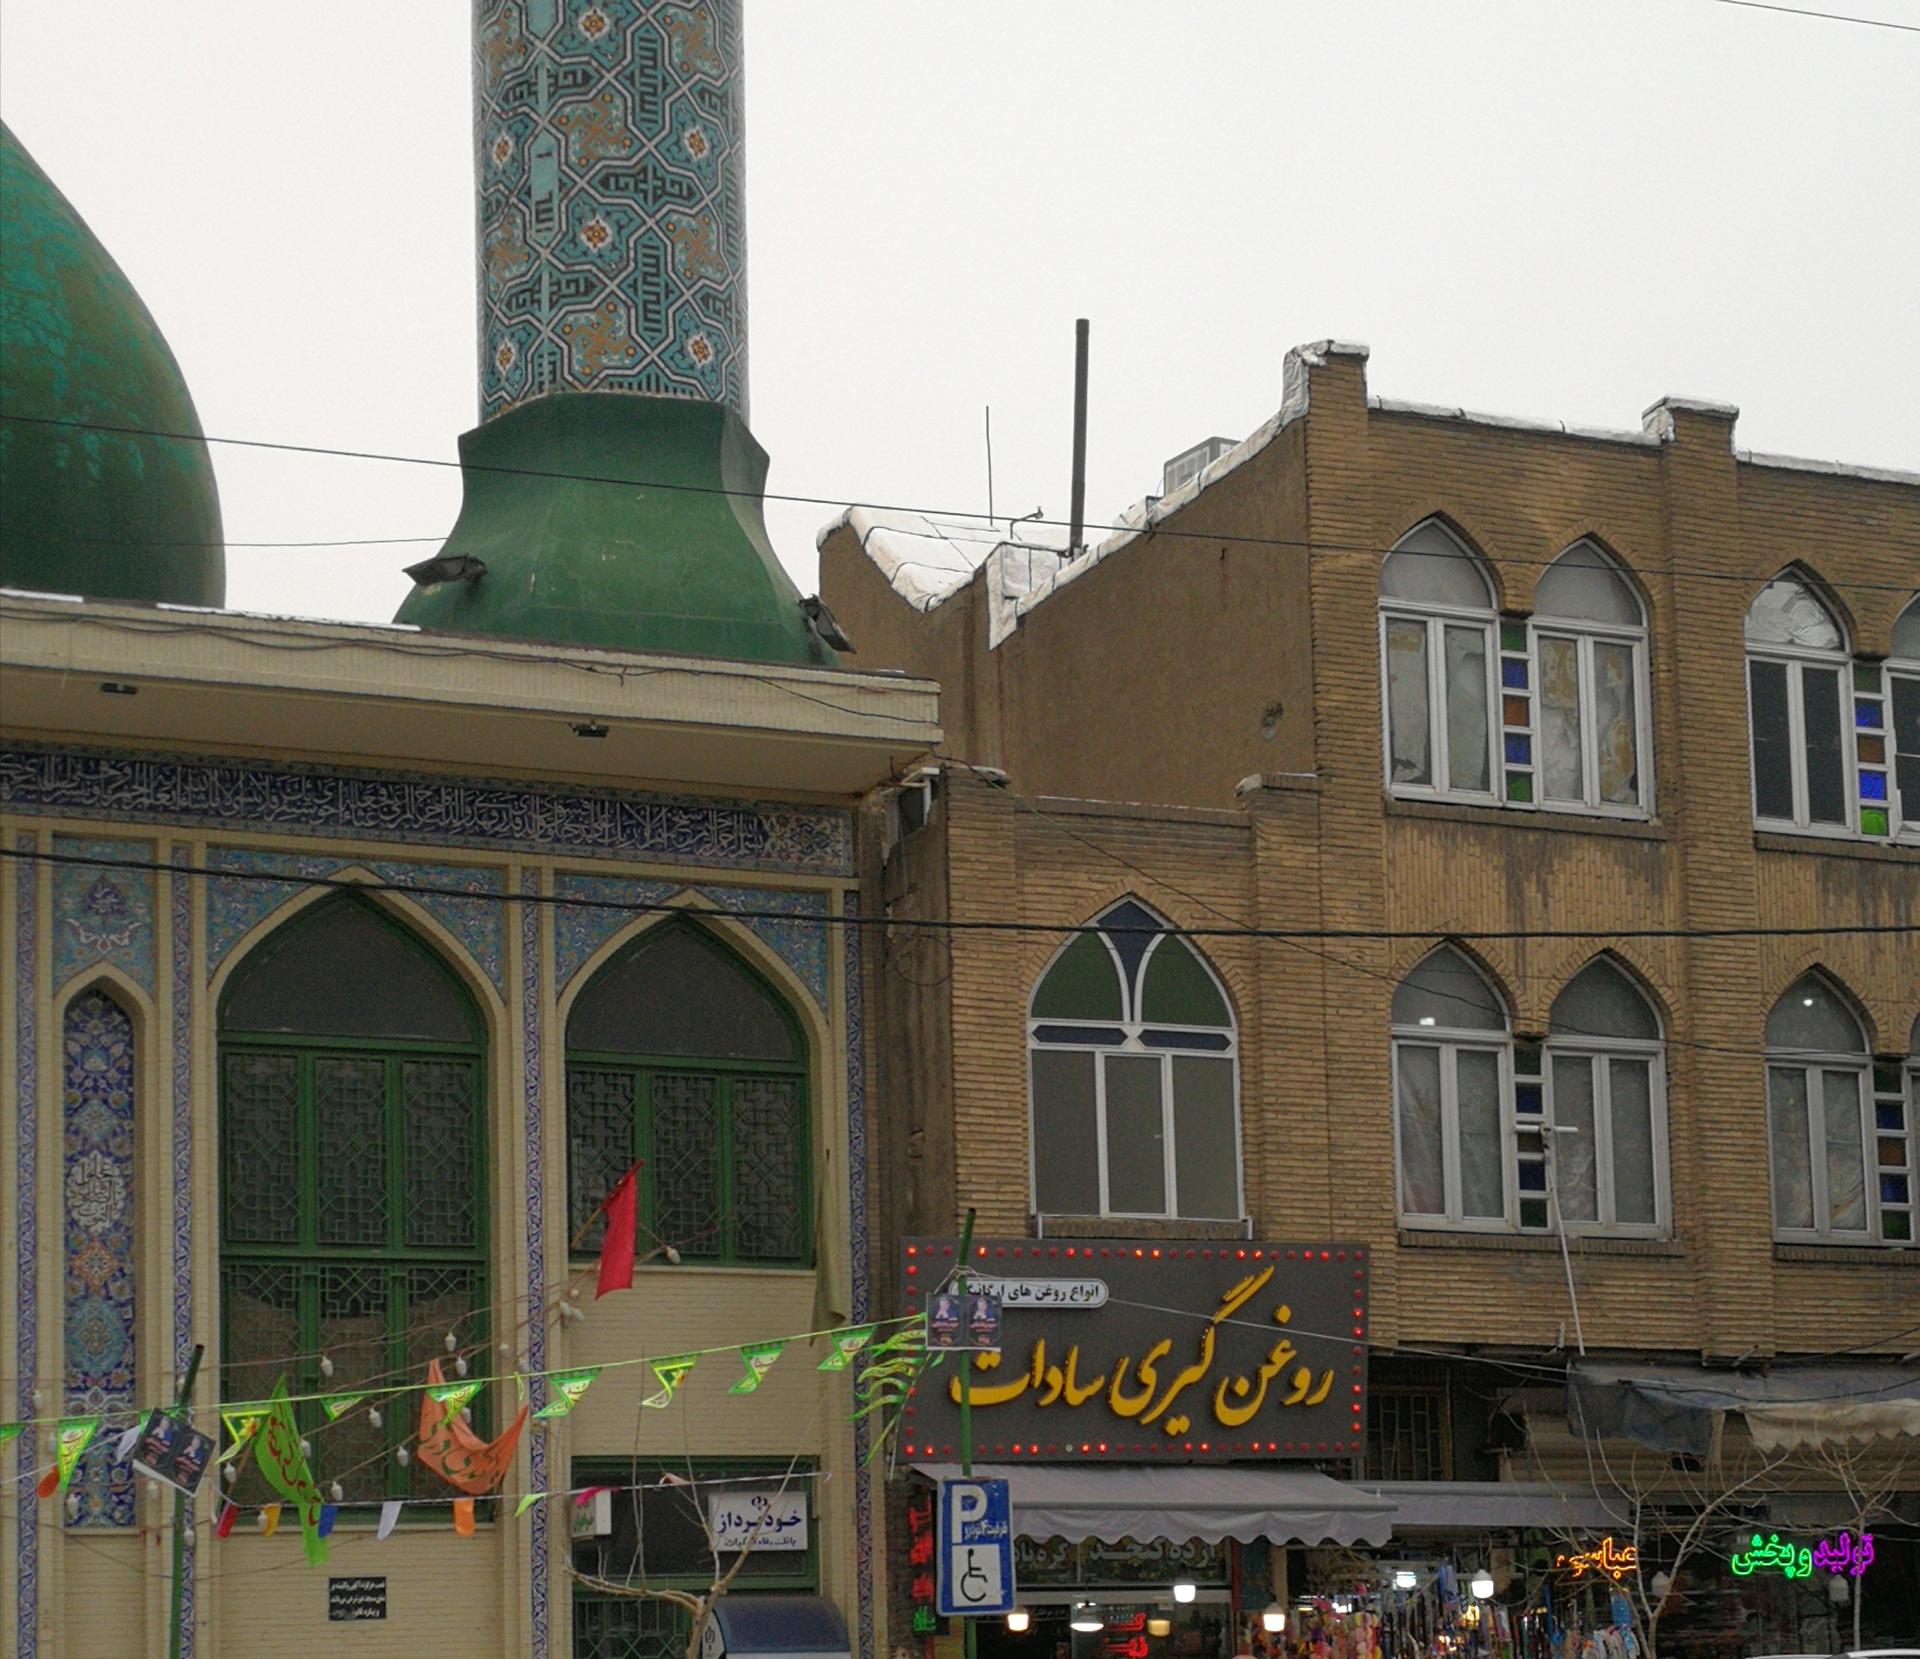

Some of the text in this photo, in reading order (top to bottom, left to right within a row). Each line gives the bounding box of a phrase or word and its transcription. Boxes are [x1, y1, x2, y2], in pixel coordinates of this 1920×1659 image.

[1007, 1283, 1032, 1302] های
[1034, 1284, 1067, 1302] روغن
[1069, 1284, 1100, 1302] انواع
[949, 1267, 1334, 1436] روغن گیری سادات
[717, 1510, 802, 1534] خودرداز
[951, 1484, 988, 1544] P
[1731, 1531, 1875, 1579] تولید و پخش
